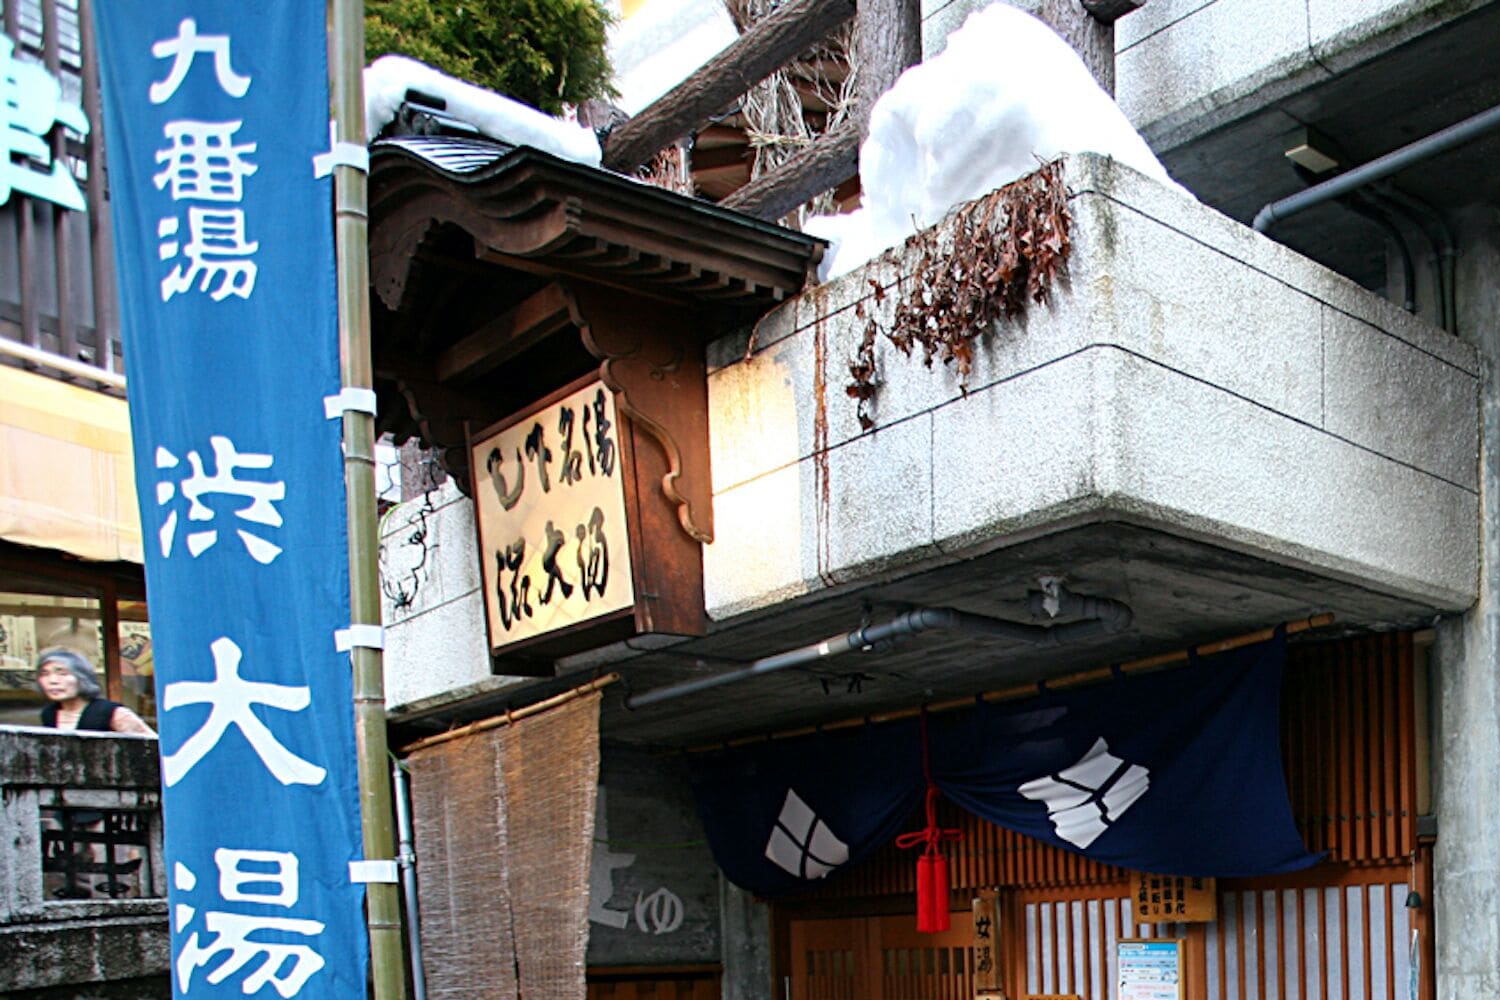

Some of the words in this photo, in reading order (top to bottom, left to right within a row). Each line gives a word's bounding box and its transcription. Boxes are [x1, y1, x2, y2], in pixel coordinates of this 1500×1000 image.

[150, 18, 259, 302] 九番湯
[157, 436, 328, 998] 渋大湯
[635, 887, 684, 935] ゆ
[976, 917, 993, 974] 女湯
